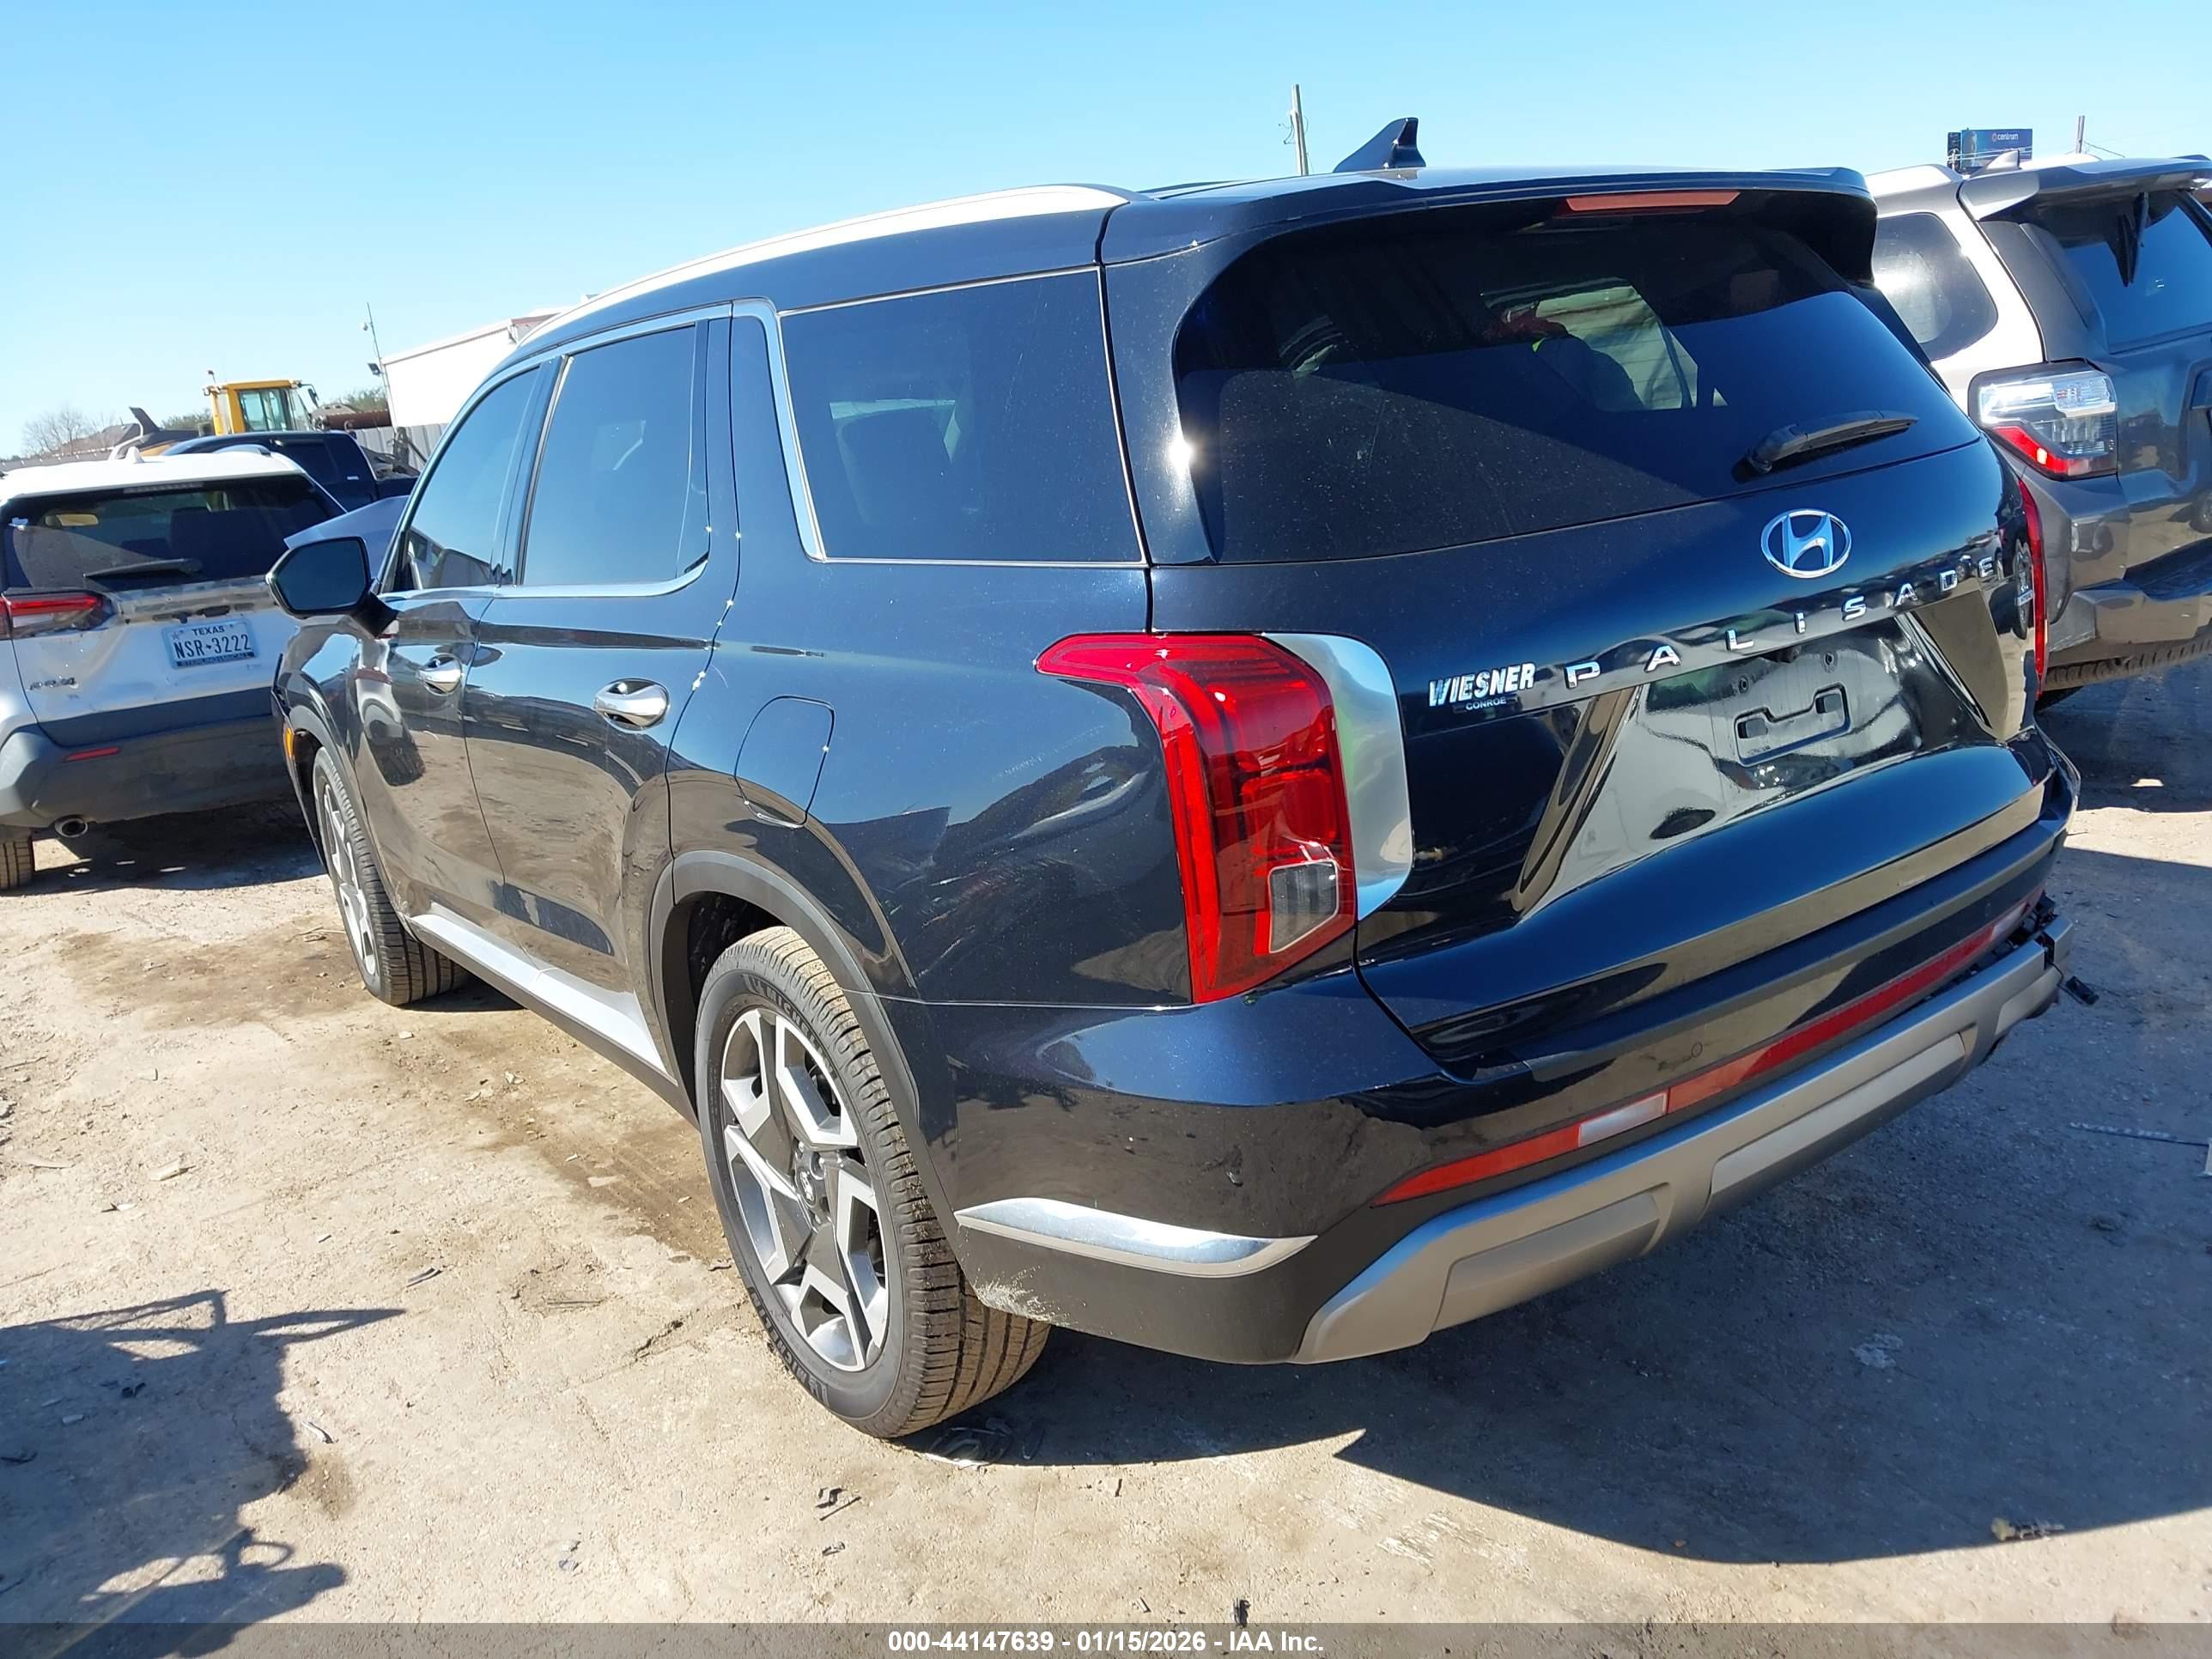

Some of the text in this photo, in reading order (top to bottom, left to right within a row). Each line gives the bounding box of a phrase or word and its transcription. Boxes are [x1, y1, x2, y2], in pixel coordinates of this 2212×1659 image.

[192, 625, 225, 636] TEXAS
[1564, 556, 1994, 689] PALISADE
[1429, 662, 1535, 707] WIESNER
[1465, 696, 1507, 711] CONROE
